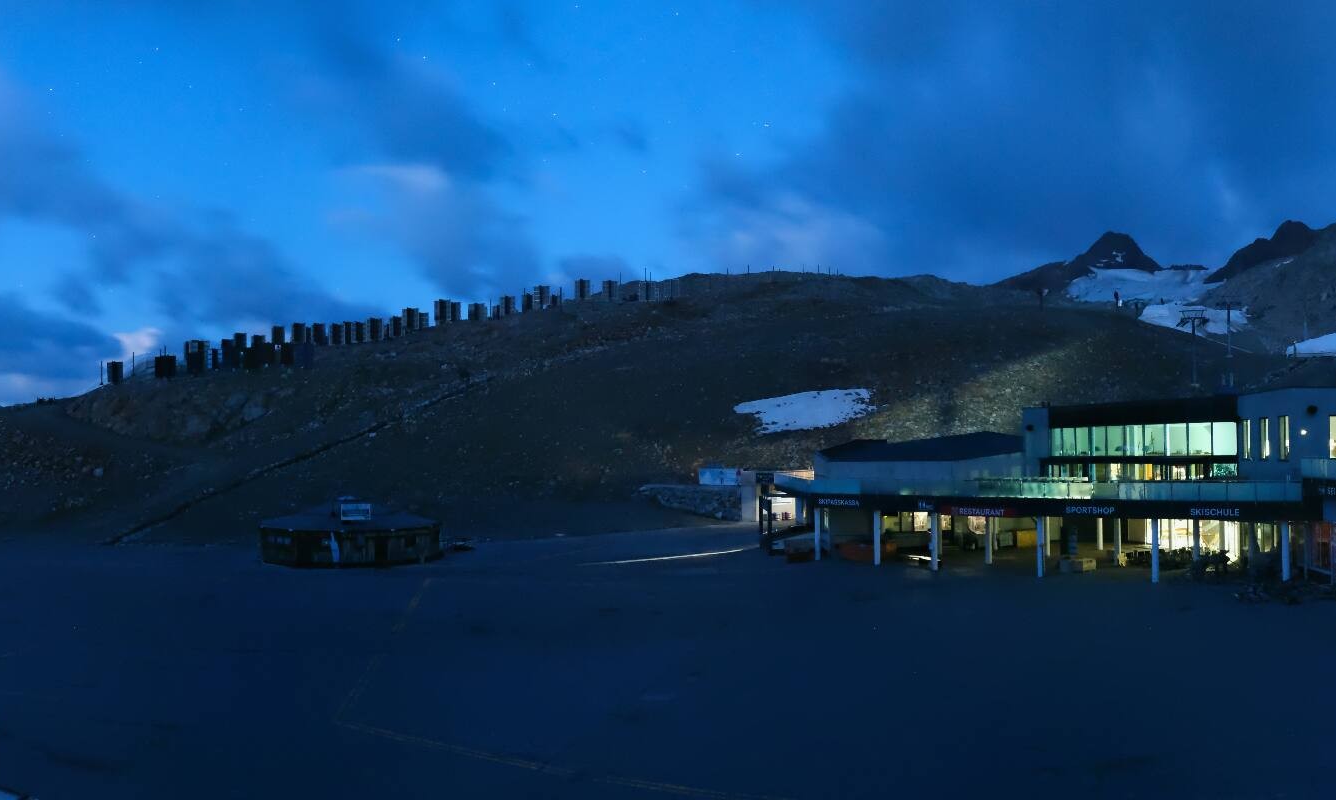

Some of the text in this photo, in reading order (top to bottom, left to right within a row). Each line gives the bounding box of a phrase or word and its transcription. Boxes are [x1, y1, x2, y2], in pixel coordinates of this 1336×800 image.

[959, 507, 1005, 516] RESTAURANT
[1065, 506, 1115, 515] SPORTSHOP
[1190, 508, 1240, 517] SKISCHULE
